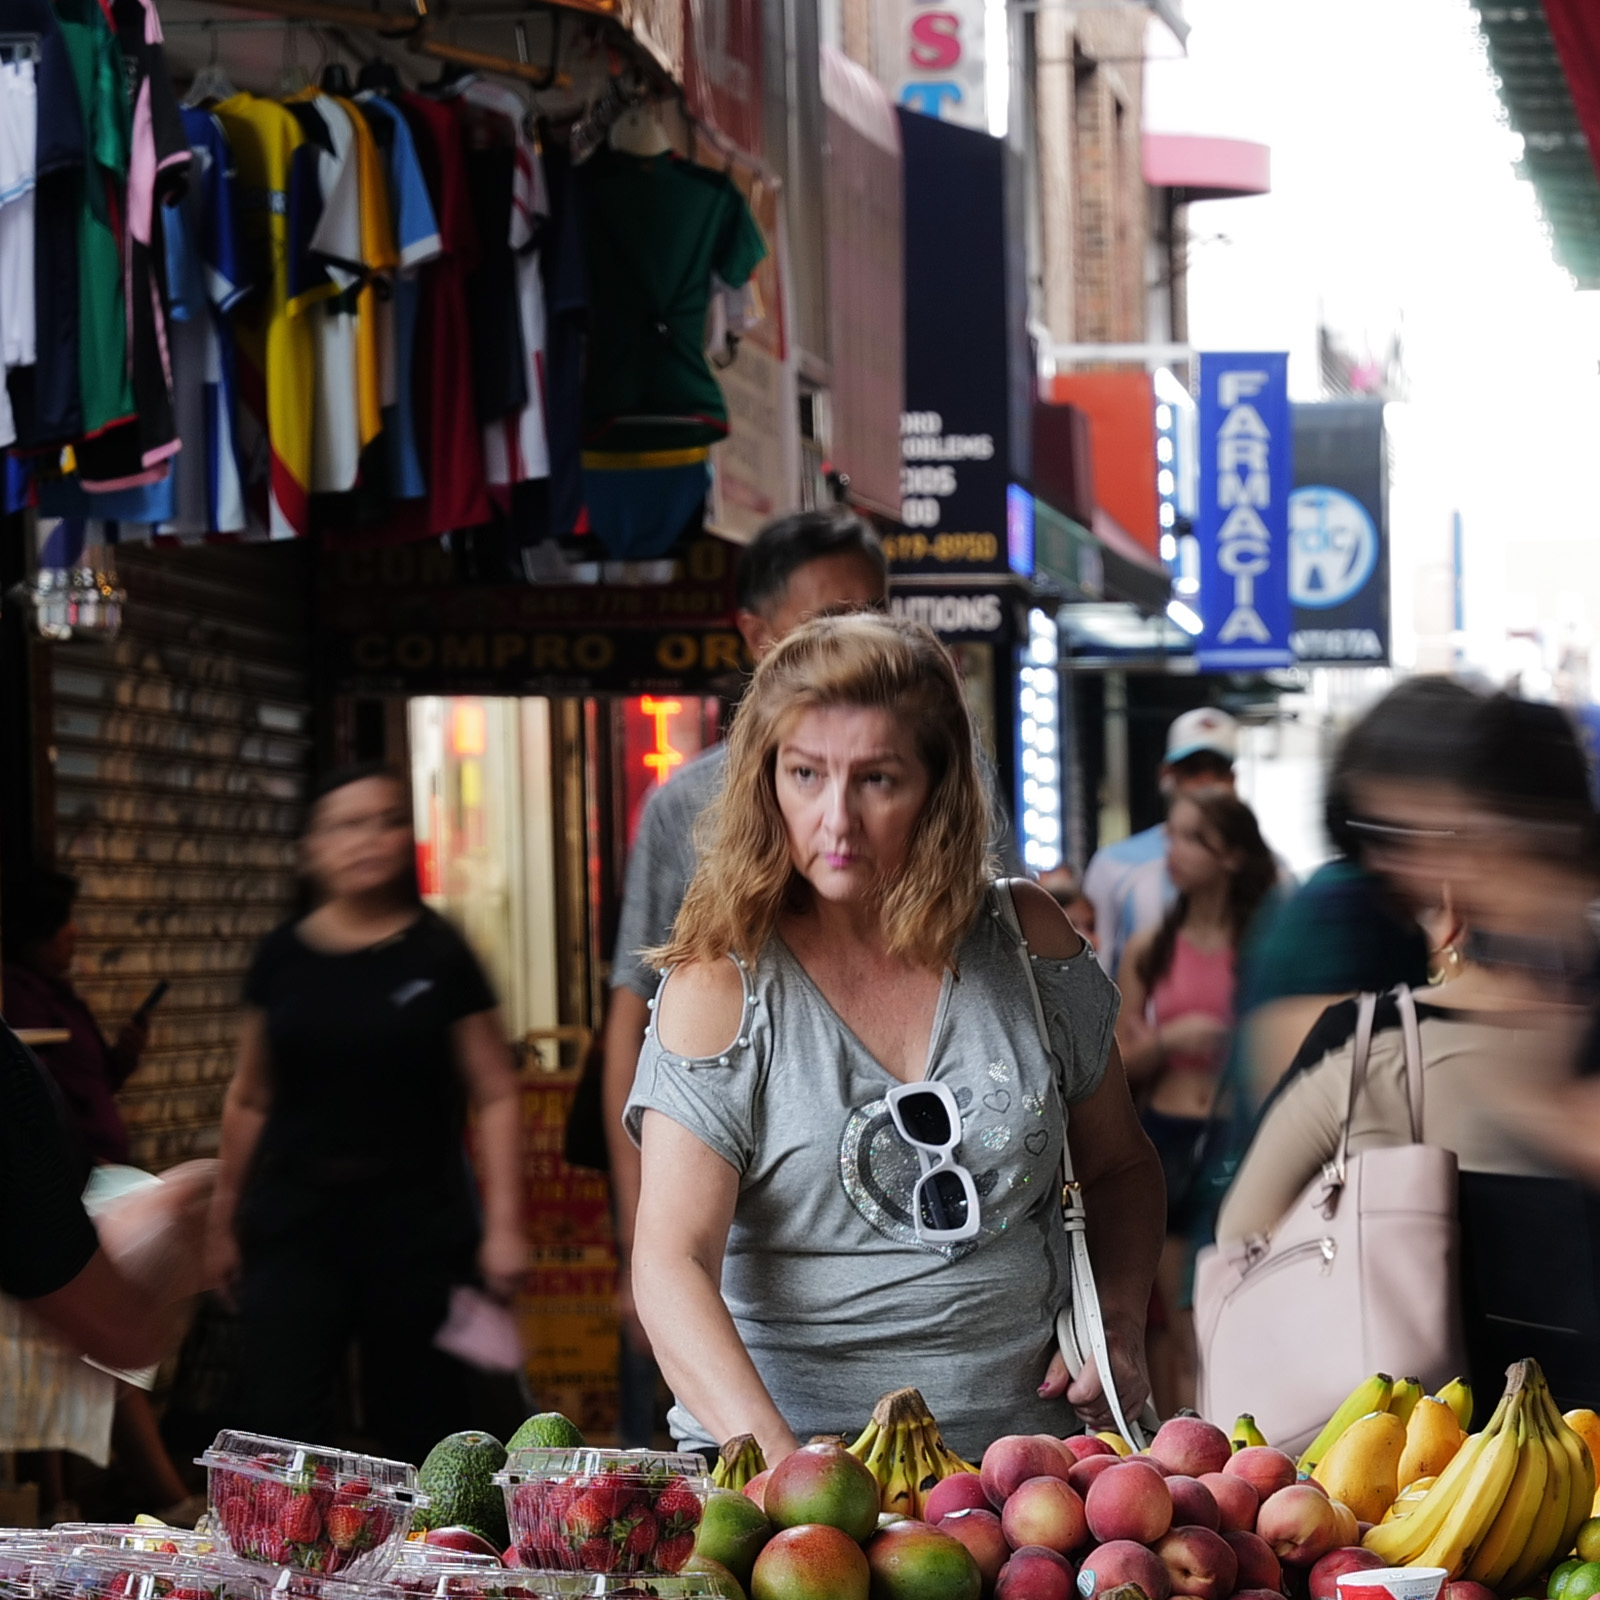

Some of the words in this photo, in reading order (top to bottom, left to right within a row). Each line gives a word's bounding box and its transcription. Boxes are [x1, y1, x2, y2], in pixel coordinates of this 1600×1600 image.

[1216, 369, 1272, 645] FARMACIA
[356, 632, 614, 670] COMPRO
[655, 632, 752, 673] OR
